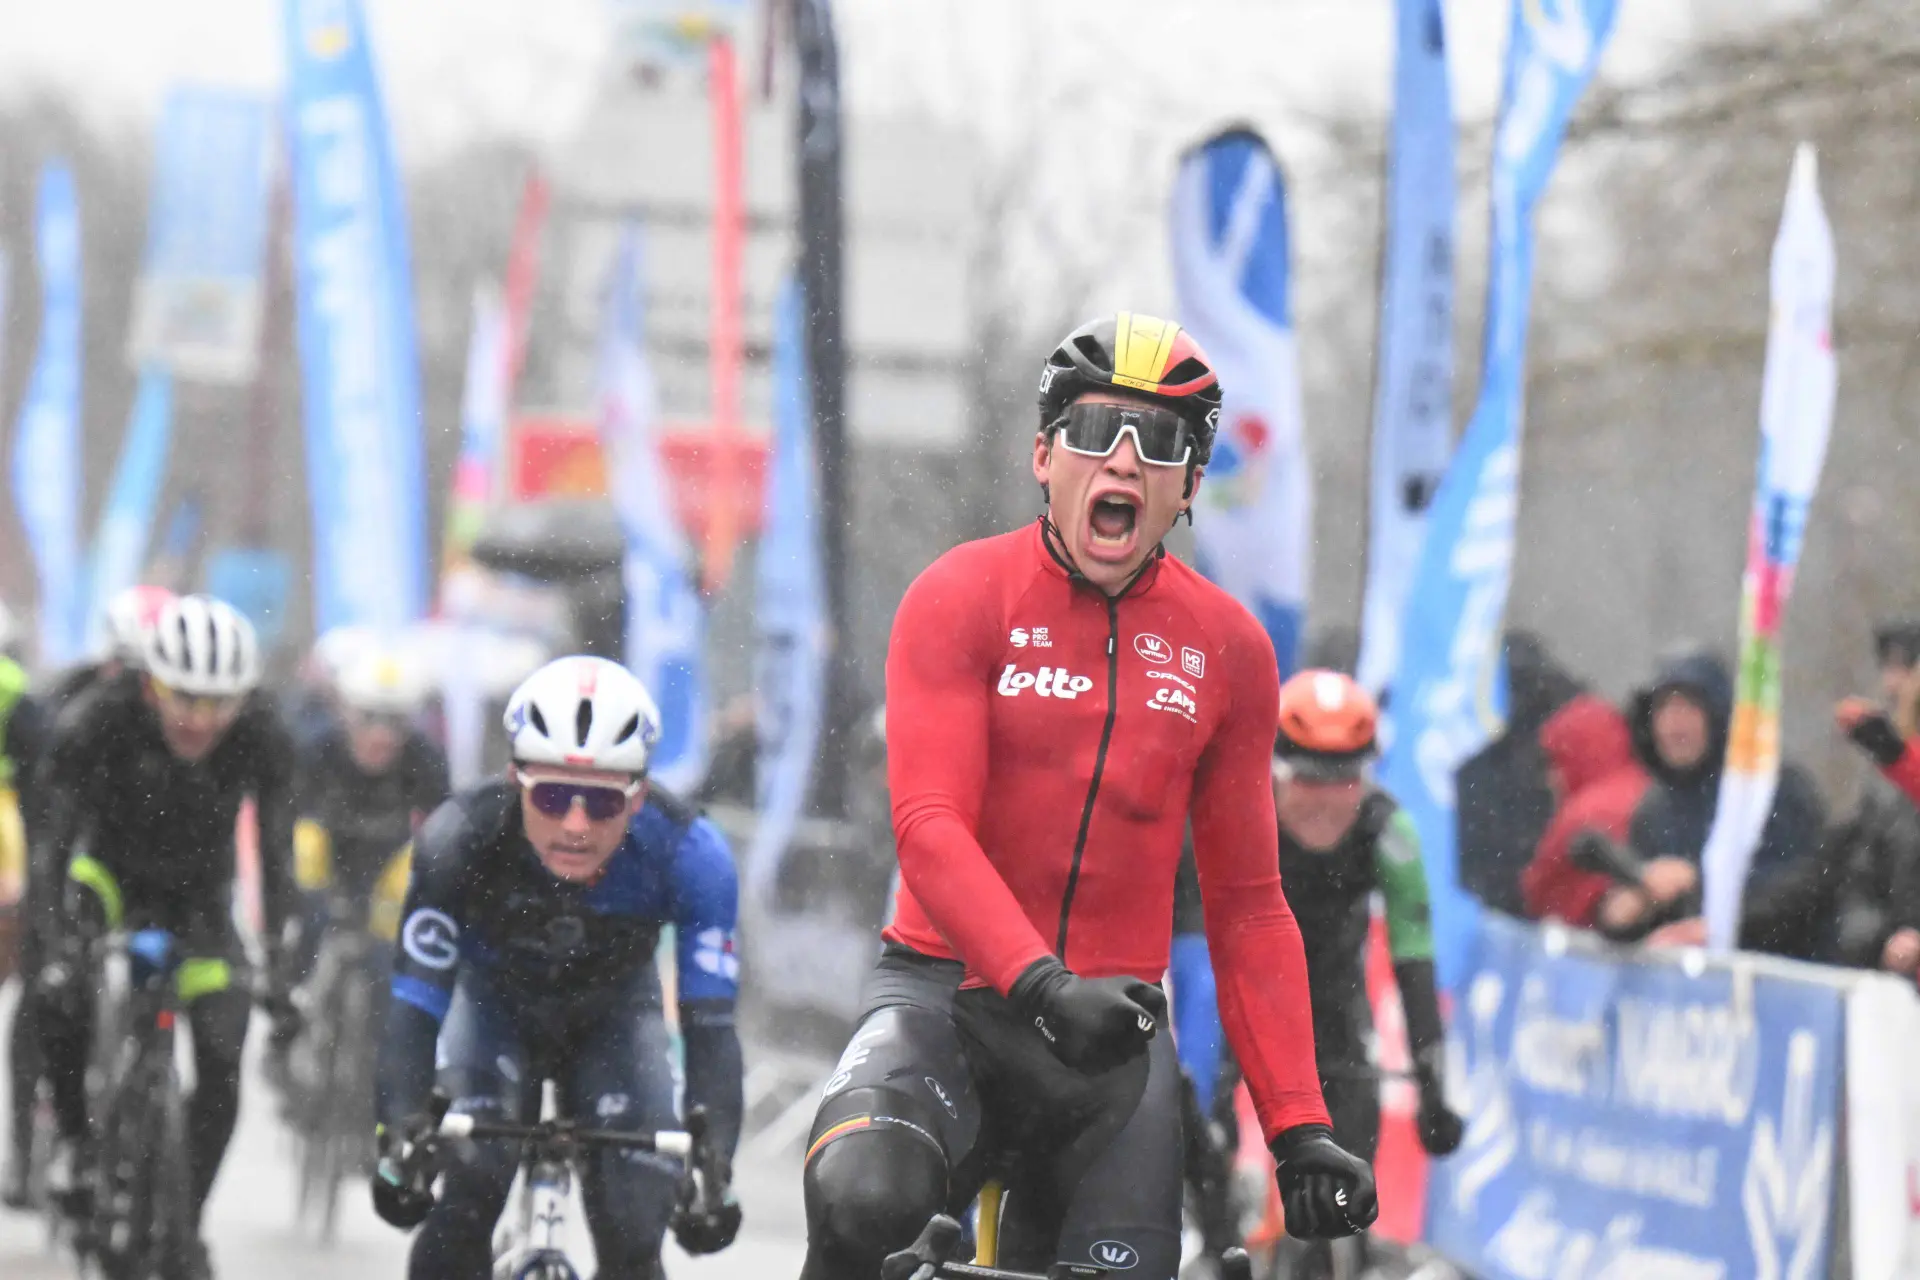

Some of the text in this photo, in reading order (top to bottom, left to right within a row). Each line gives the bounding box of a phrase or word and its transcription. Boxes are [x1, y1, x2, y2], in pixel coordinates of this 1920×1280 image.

[1032, 640, 1053, 648] TEAM
[1185, 652, 1201, 668] MR
[1155, 688, 1196, 714] CAPS
